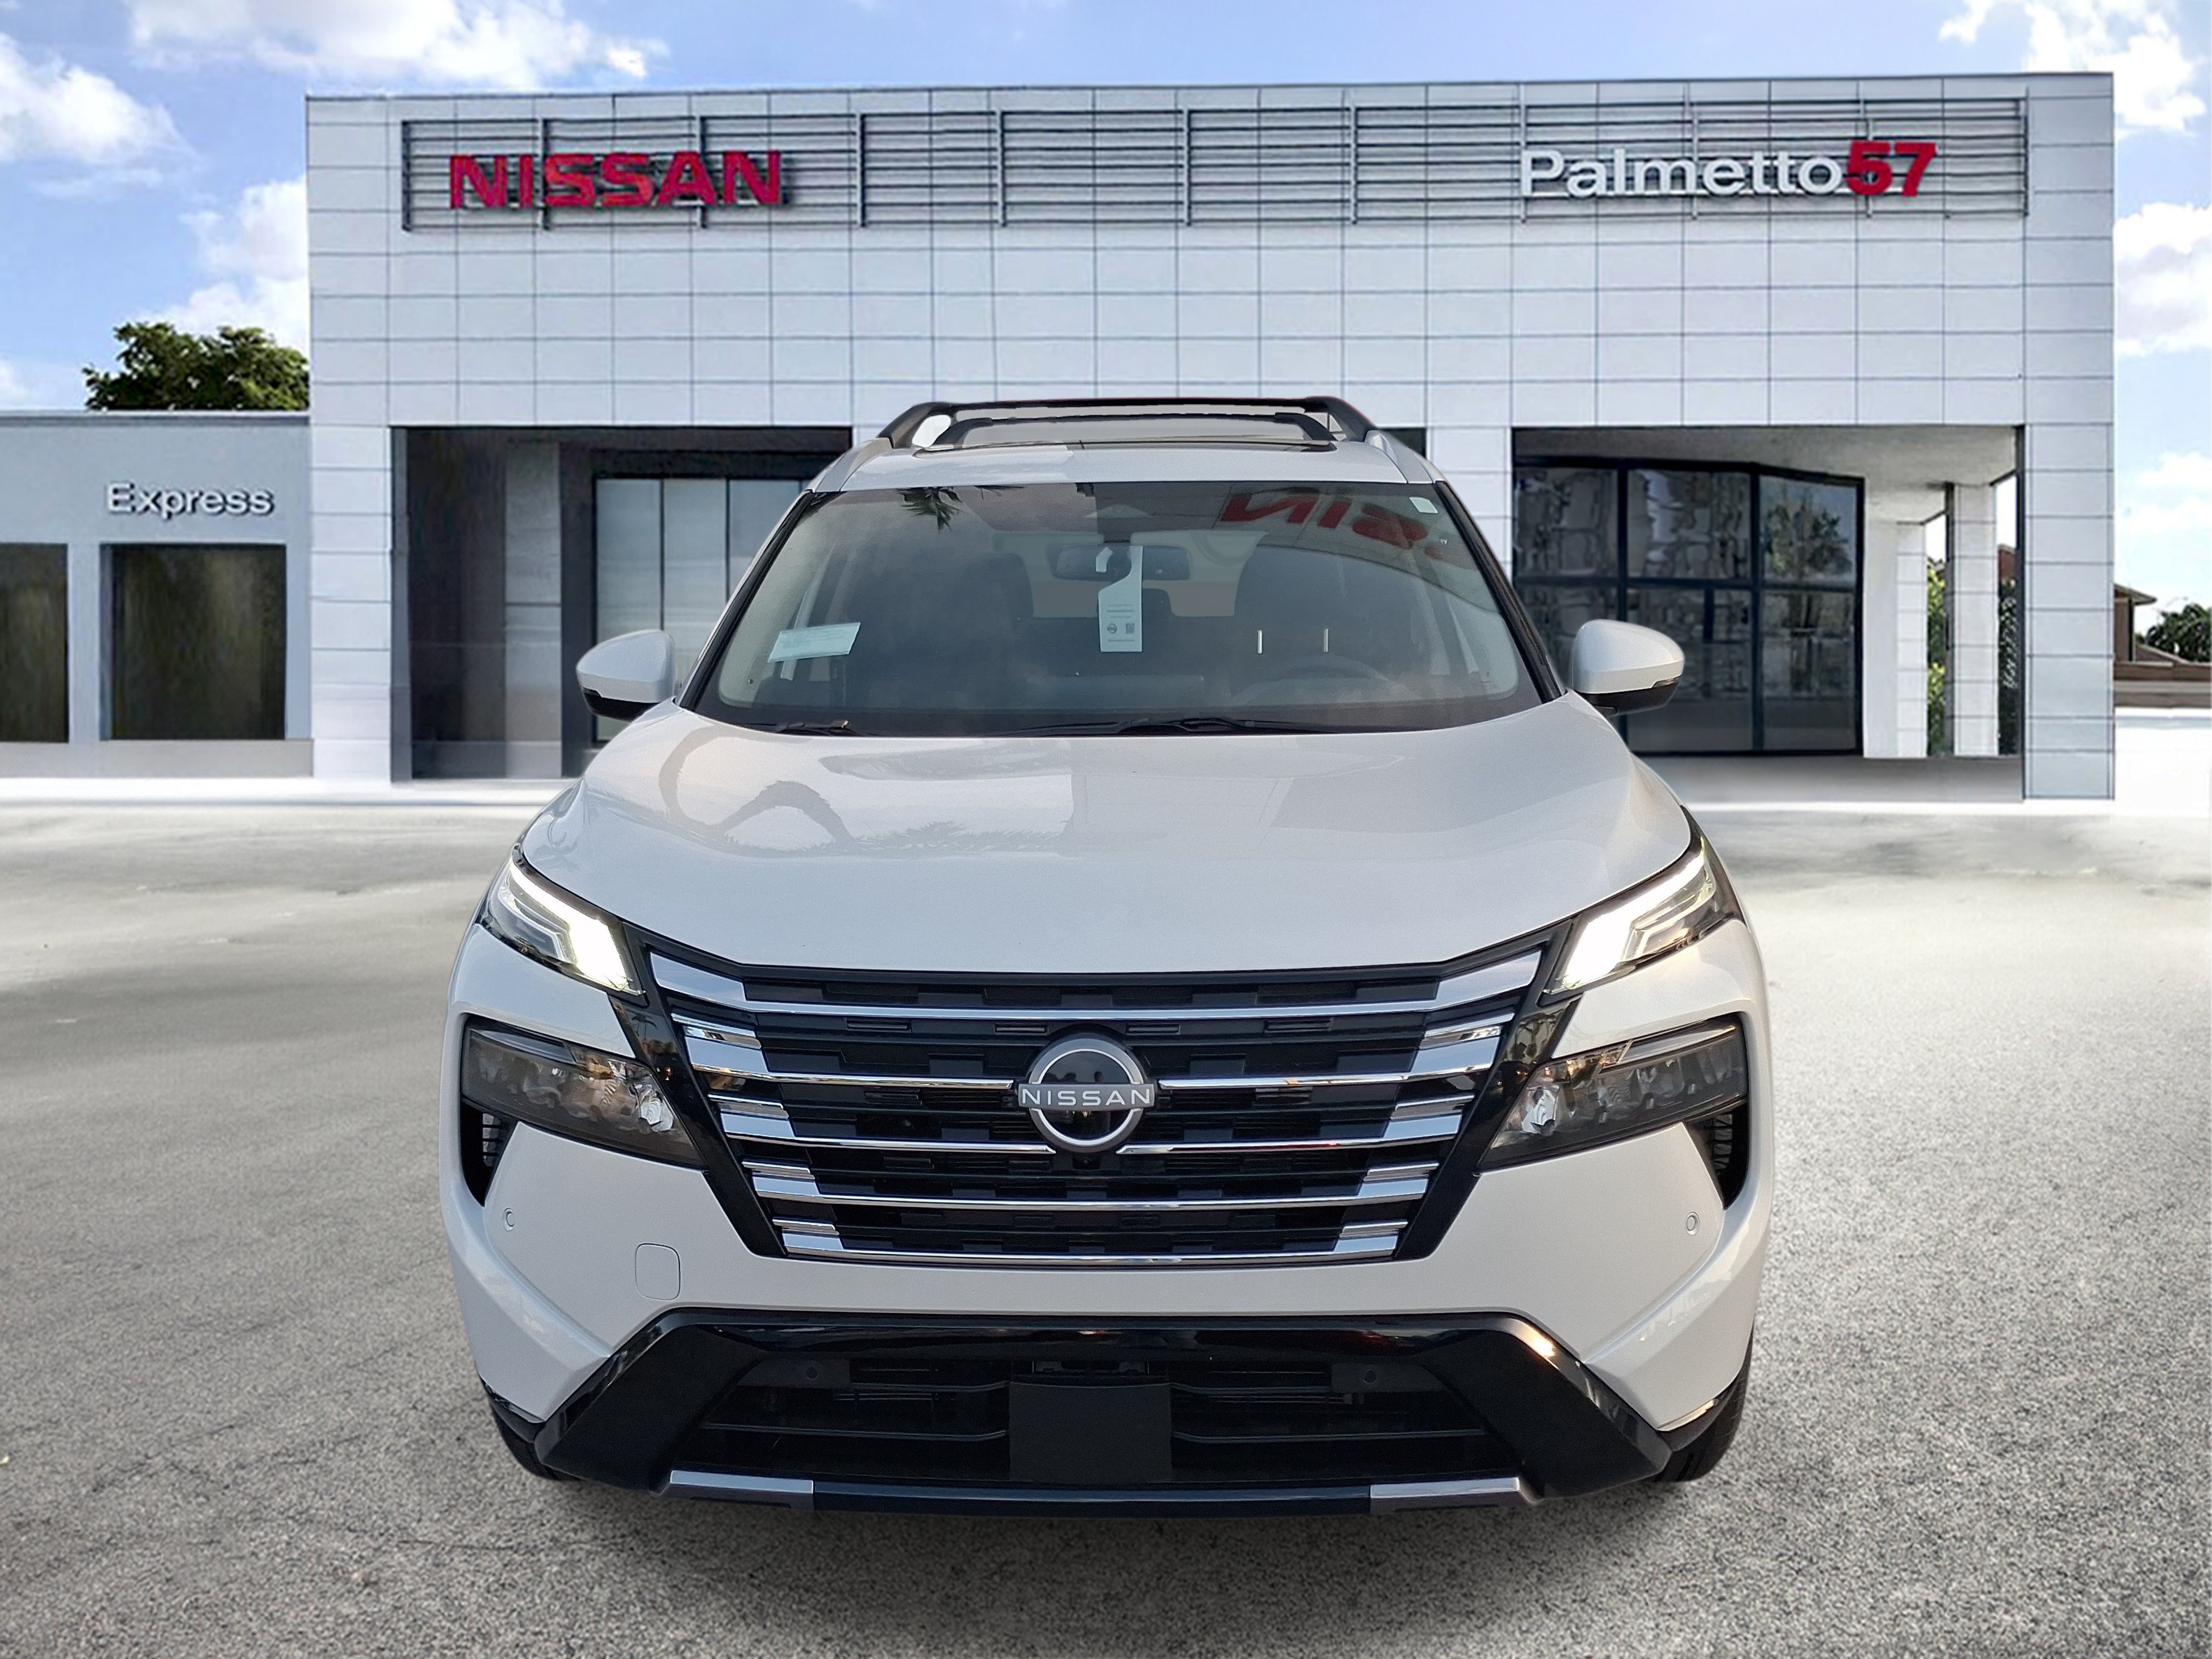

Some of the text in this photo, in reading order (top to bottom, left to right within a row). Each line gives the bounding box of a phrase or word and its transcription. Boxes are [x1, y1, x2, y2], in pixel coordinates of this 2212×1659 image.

[449, 150, 783, 209] NISSAN
[108, 483, 274, 520] Express
[1022, 1088, 1150, 1106] NISSAN
